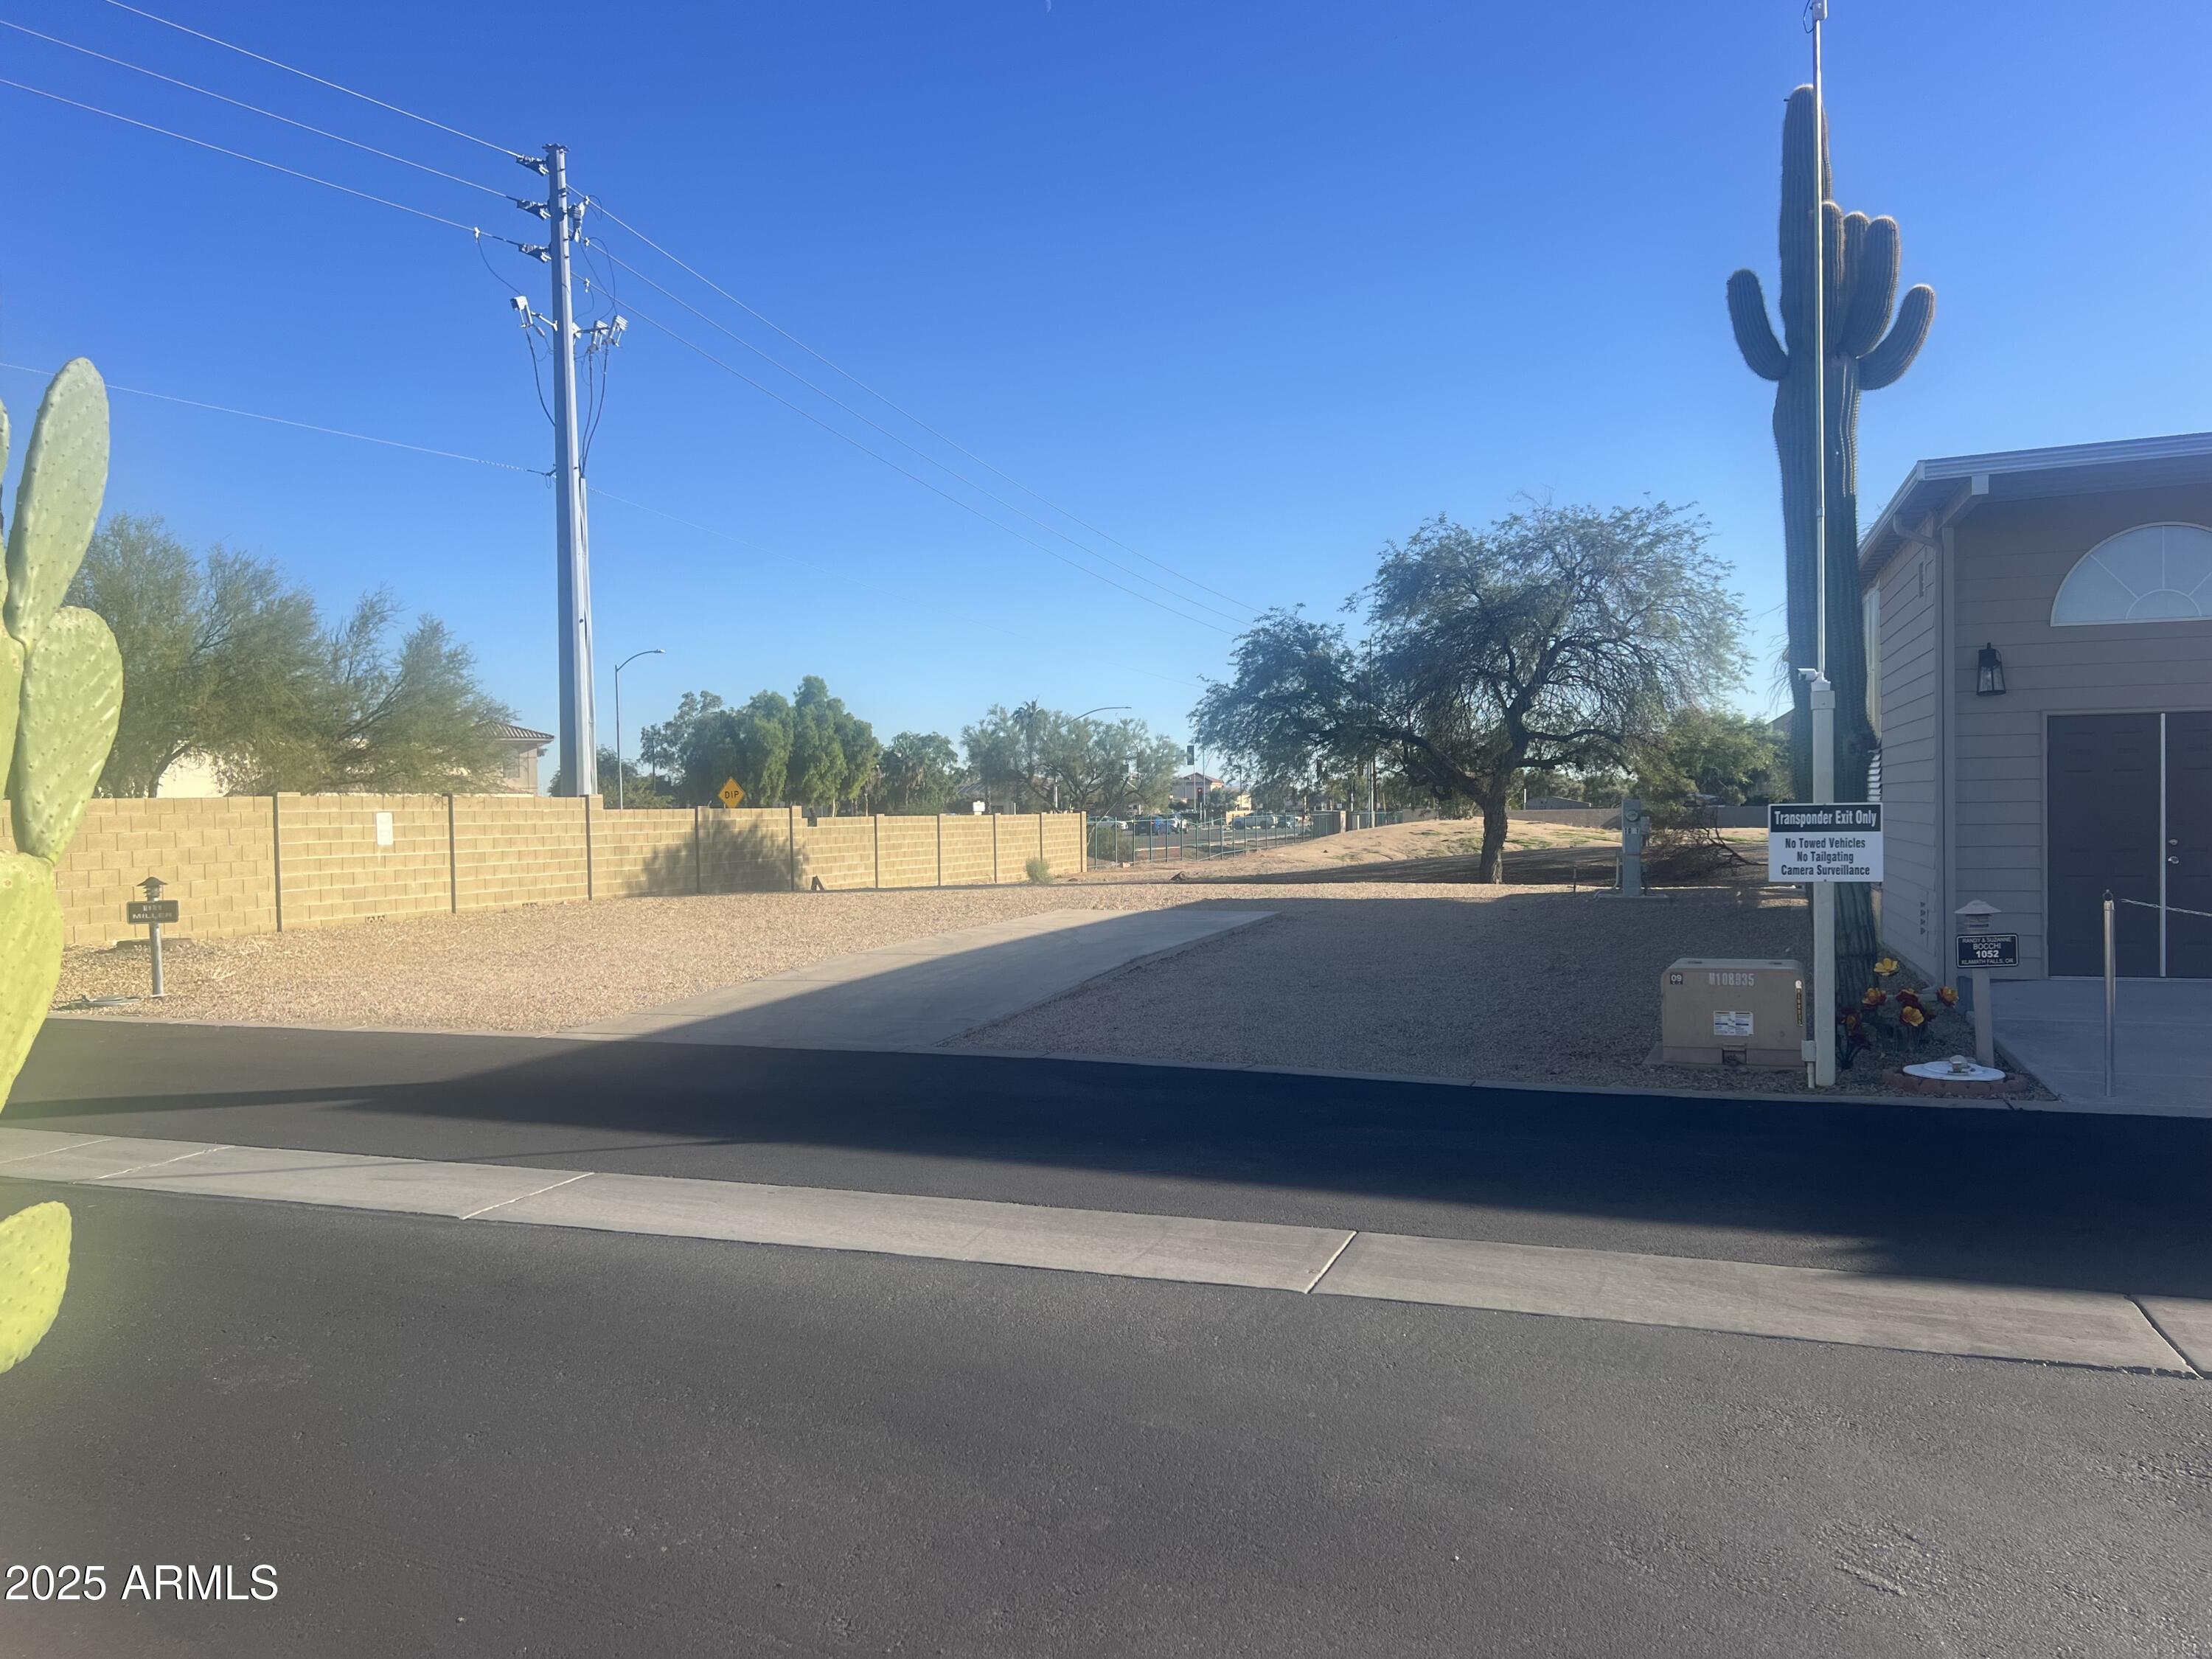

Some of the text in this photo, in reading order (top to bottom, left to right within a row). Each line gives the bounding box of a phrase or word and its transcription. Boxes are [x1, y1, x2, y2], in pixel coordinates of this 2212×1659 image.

[725, 790, 739, 799] DIP
[1774, 810, 1877, 828] Transponder Exit Only
[1785, 838, 1865, 849] No Towed Vehicles
[1797, 851, 1854, 863] No Tailgating
[1781, 864, 1871, 875] Camera Surveillance
[1976, 950, 2000, 958] 1052
